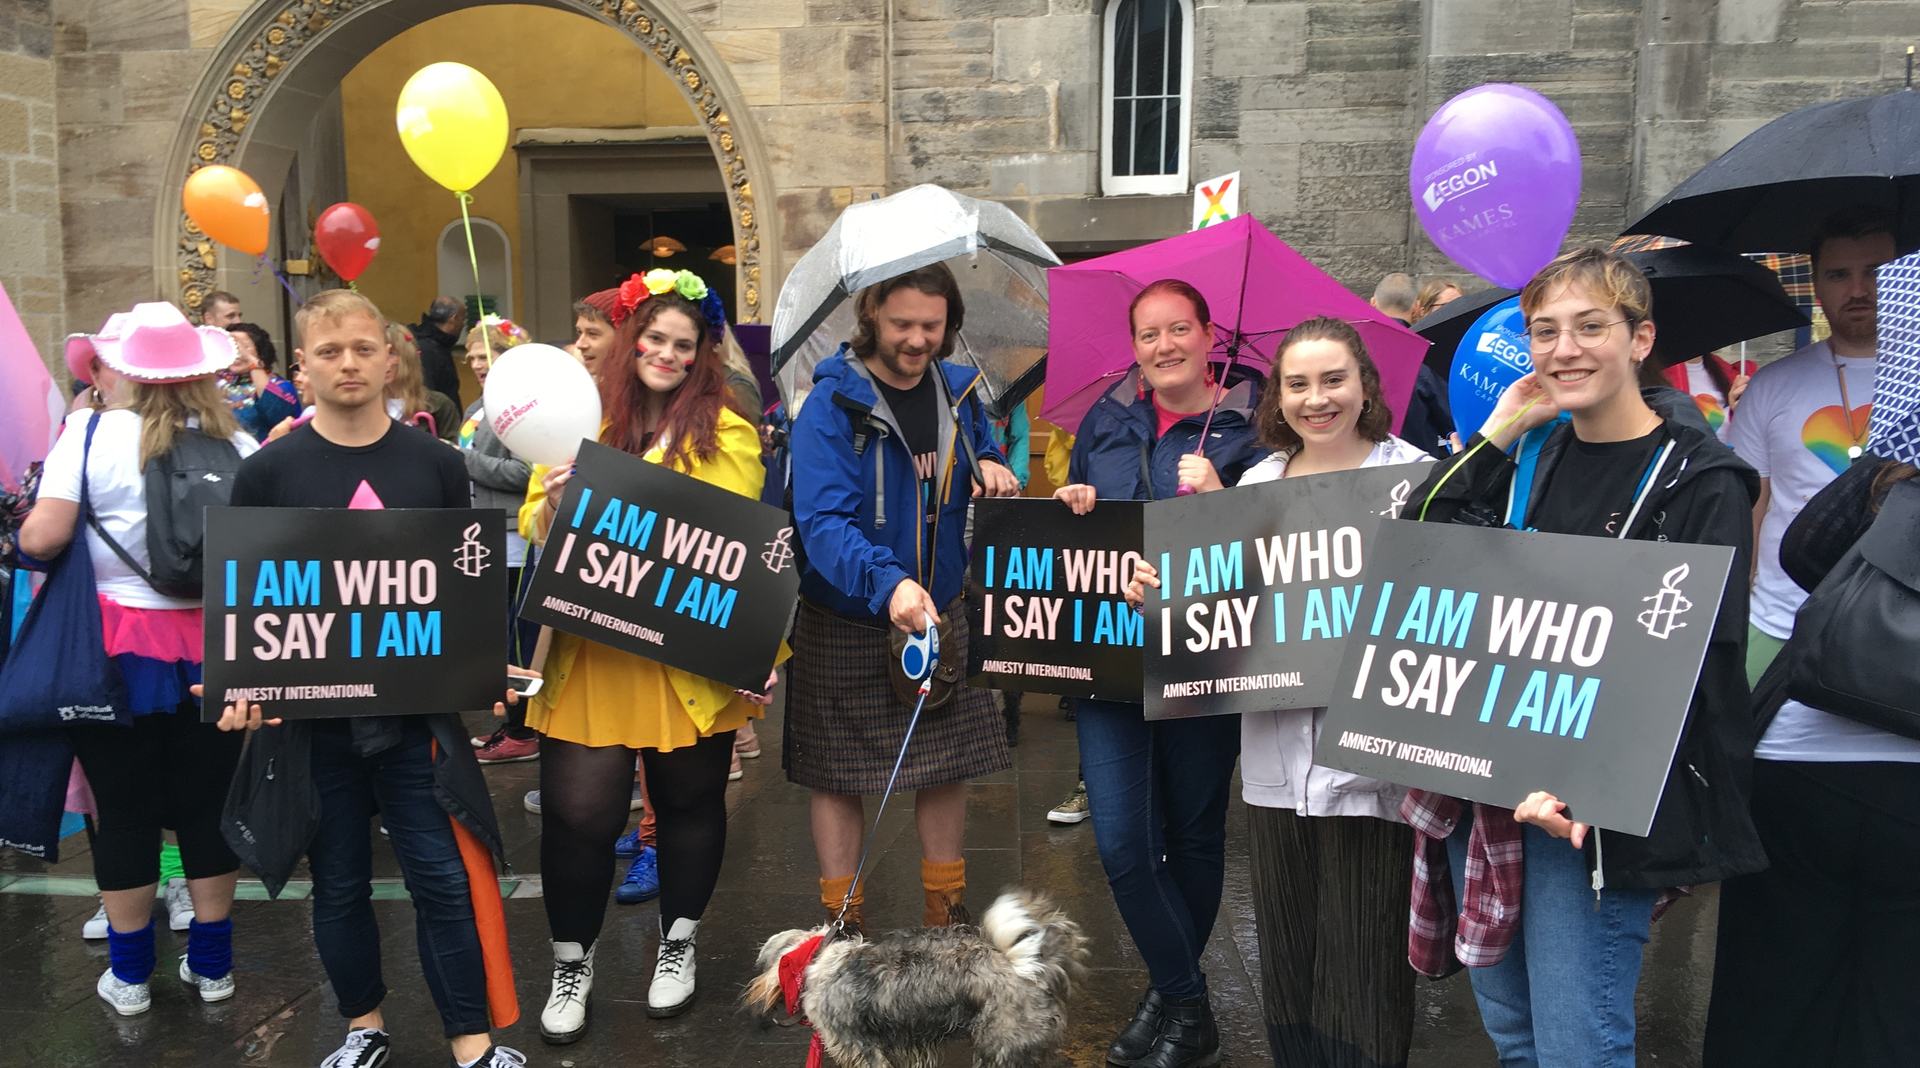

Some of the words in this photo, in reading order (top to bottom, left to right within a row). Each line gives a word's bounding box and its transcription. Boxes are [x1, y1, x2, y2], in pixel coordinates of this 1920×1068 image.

[1439, 203, 1514, 242] KAMES
[571, 488, 593, 529] I
[592, 498, 658, 551] AM
[662, 517, 747, 582] WHO
[225, 560, 237, 607] I
[252, 560, 321, 607] AM
[333, 559, 437, 605] WHO
[554, 533, 577, 574] I
[579, 543, 655, 598] SAY
[654, 566, 675, 608] I
[675, 576, 738, 629] AM
[985, 546, 995, 588] I
[1004, 546, 1054, 591] AM
[1161, 552, 1170, 600] I
[1184, 540, 1244, 597] AM
[1255, 526, 1363, 586] WHO
[225, 614, 237, 661] I
[252, 612, 336, 661] SAY
[350, 612, 362, 658] I
[376, 611, 442, 657] AM
[542, 595, 593, 621] AMNESTY
[590, 611, 665, 646] INTERNATIONAL
[984, 594, 993, 636] I
[1003, 594, 1064, 641] SAY
[1073, 599, 1083, 643] I
[1093, 601, 1144, 647] AM
[1161, 607, 1171, 656] I
[1185, 595, 1259, 653] SAY
[1274, 592, 1286, 643] I
[1370, 581, 1394, 636] I
[1396, 585, 1479, 649] AM
[1488, 595, 1613, 667] WHO
[223, 687, 283, 702] AMNESTY
[285, 684, 377, 699] INTERNATIONAL
[982, 660, 1025, 675] AMNESTY
[1025, 663, 1093, 681] INTERNATIONAL
[1163, 680, 1213, 699] AMNESTY
[1215, 671, 1304, 693] INTERNATIONAL
[1352, 644, 1376, 699] I
[1381, 649, 1478, 716] SAY
[1479, 664, 1506, 723] I
[1507, 670, 1601, 740] AM
[1338, 731, 1397, 757] AMNESTY
[1396, 742, 1493, 778] INTERNATIONAL
